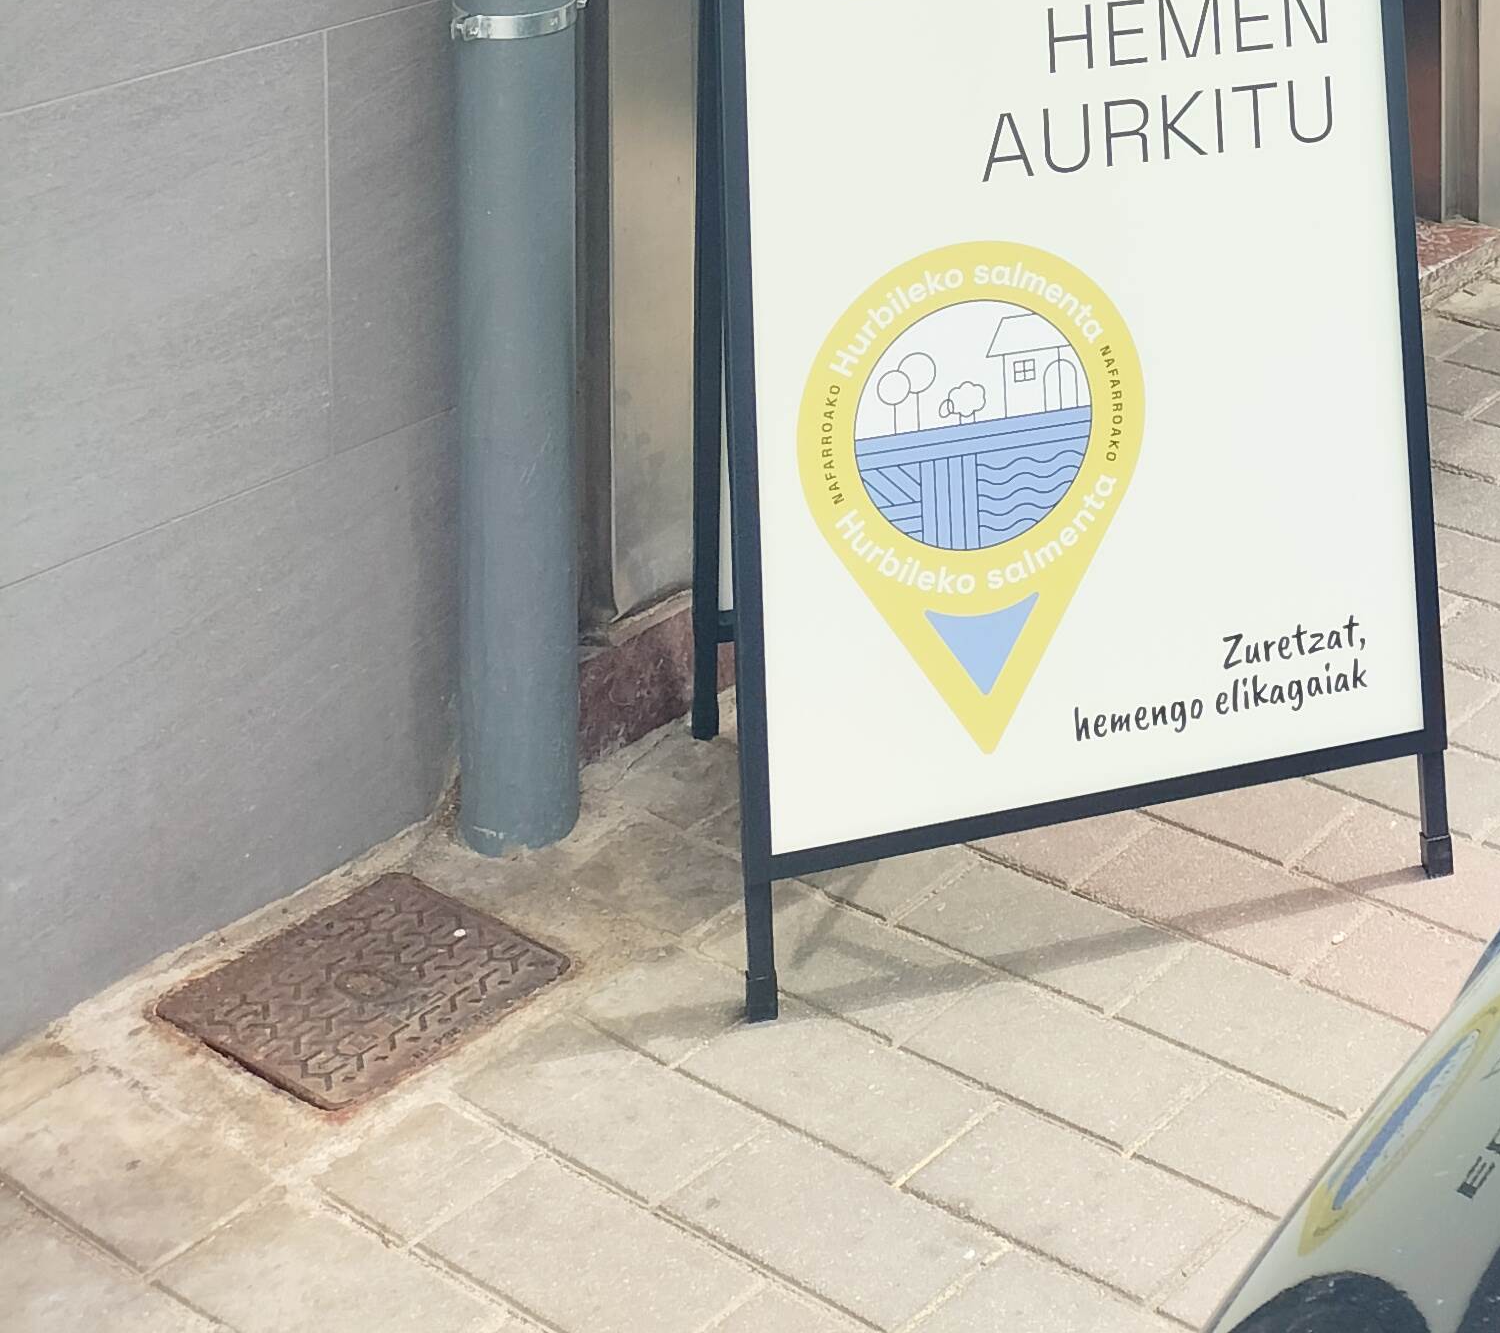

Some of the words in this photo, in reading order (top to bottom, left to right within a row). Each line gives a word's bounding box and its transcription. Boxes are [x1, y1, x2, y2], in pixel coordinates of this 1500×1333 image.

[982, 76, 1335, 182] AURKITU
[829, 267, 964, 378] Hurbileko
[973, 262, 1104, 344] salmenta
[821, 384, 846, 506] NAFARROAKO
[1099, 345, 1124, 462] NAFARROAKO
[834, 508, 976, 595] Hurbileko
[987, 473, 1118, 589] salmenta
[1074, 698, 1204, 742] hemengo
[1215, 658, 1368, 714] elikagaiak
[1223, 615, 1367, 670] Zuretzat,
